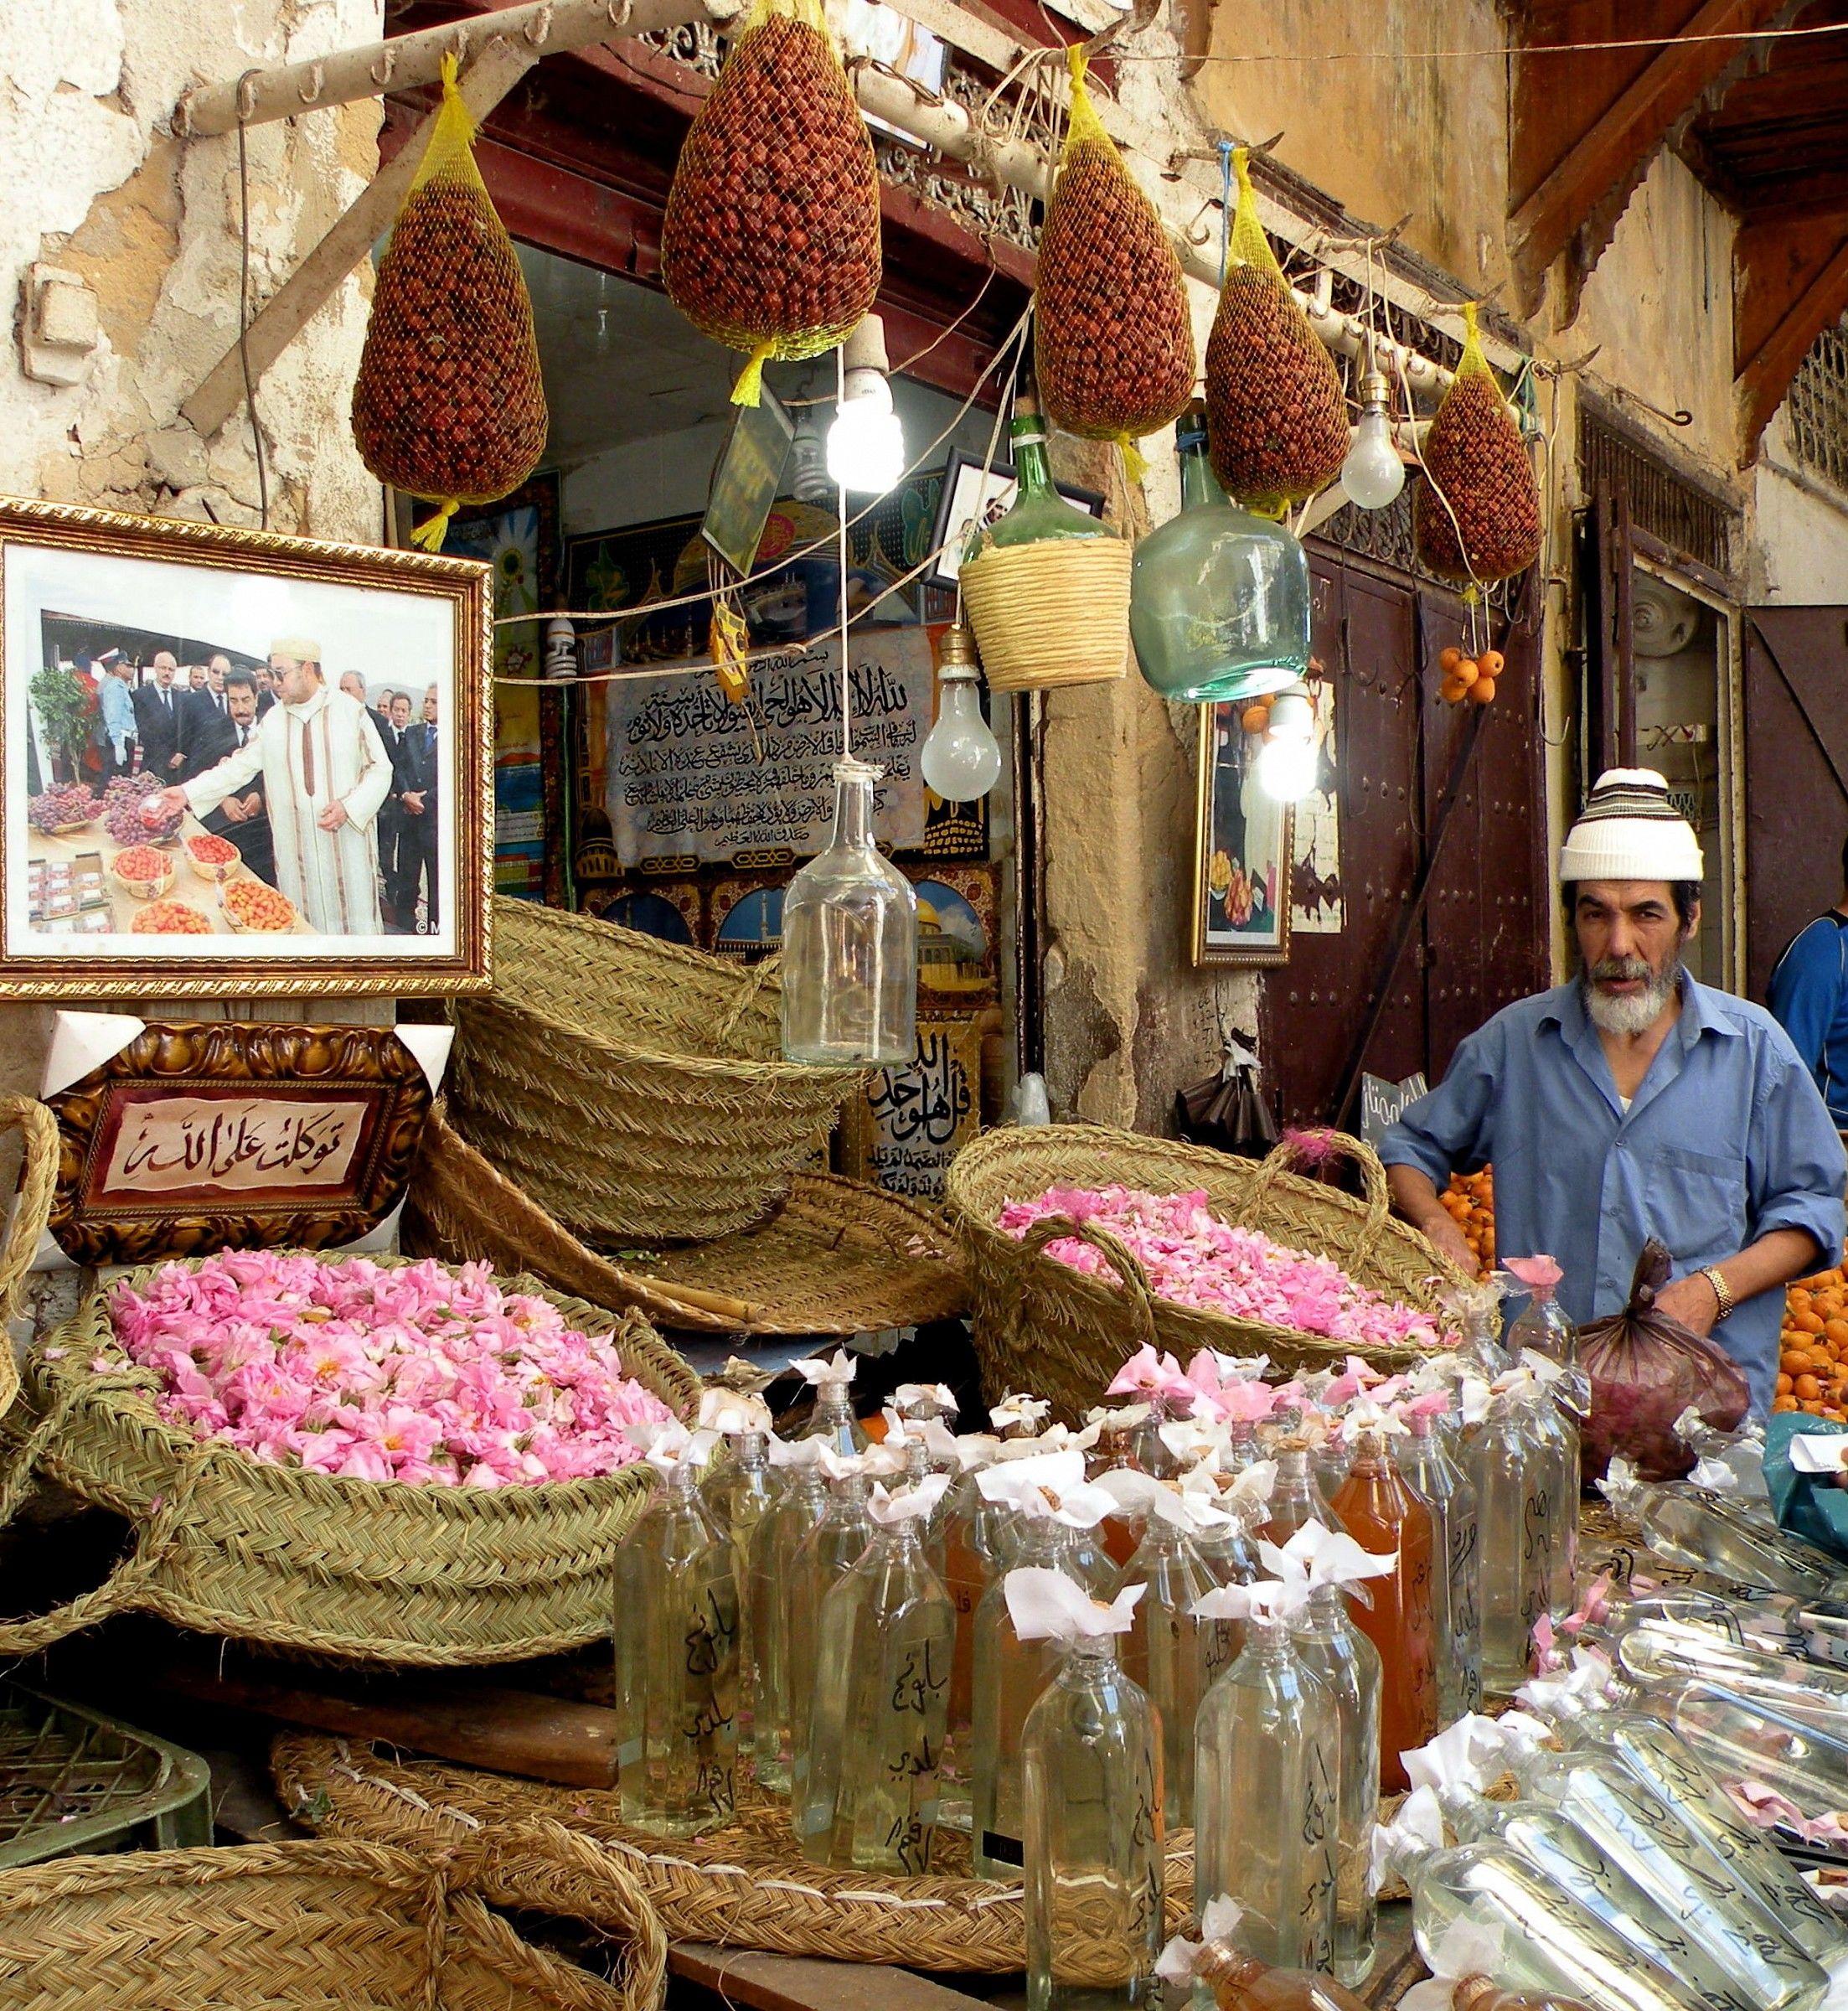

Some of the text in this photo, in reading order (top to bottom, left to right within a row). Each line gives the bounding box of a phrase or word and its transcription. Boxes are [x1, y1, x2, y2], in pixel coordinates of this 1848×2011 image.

[123, 1104, 345, 1180] توكلت على الله
[889, 1734, 939, 1783] بلدي
